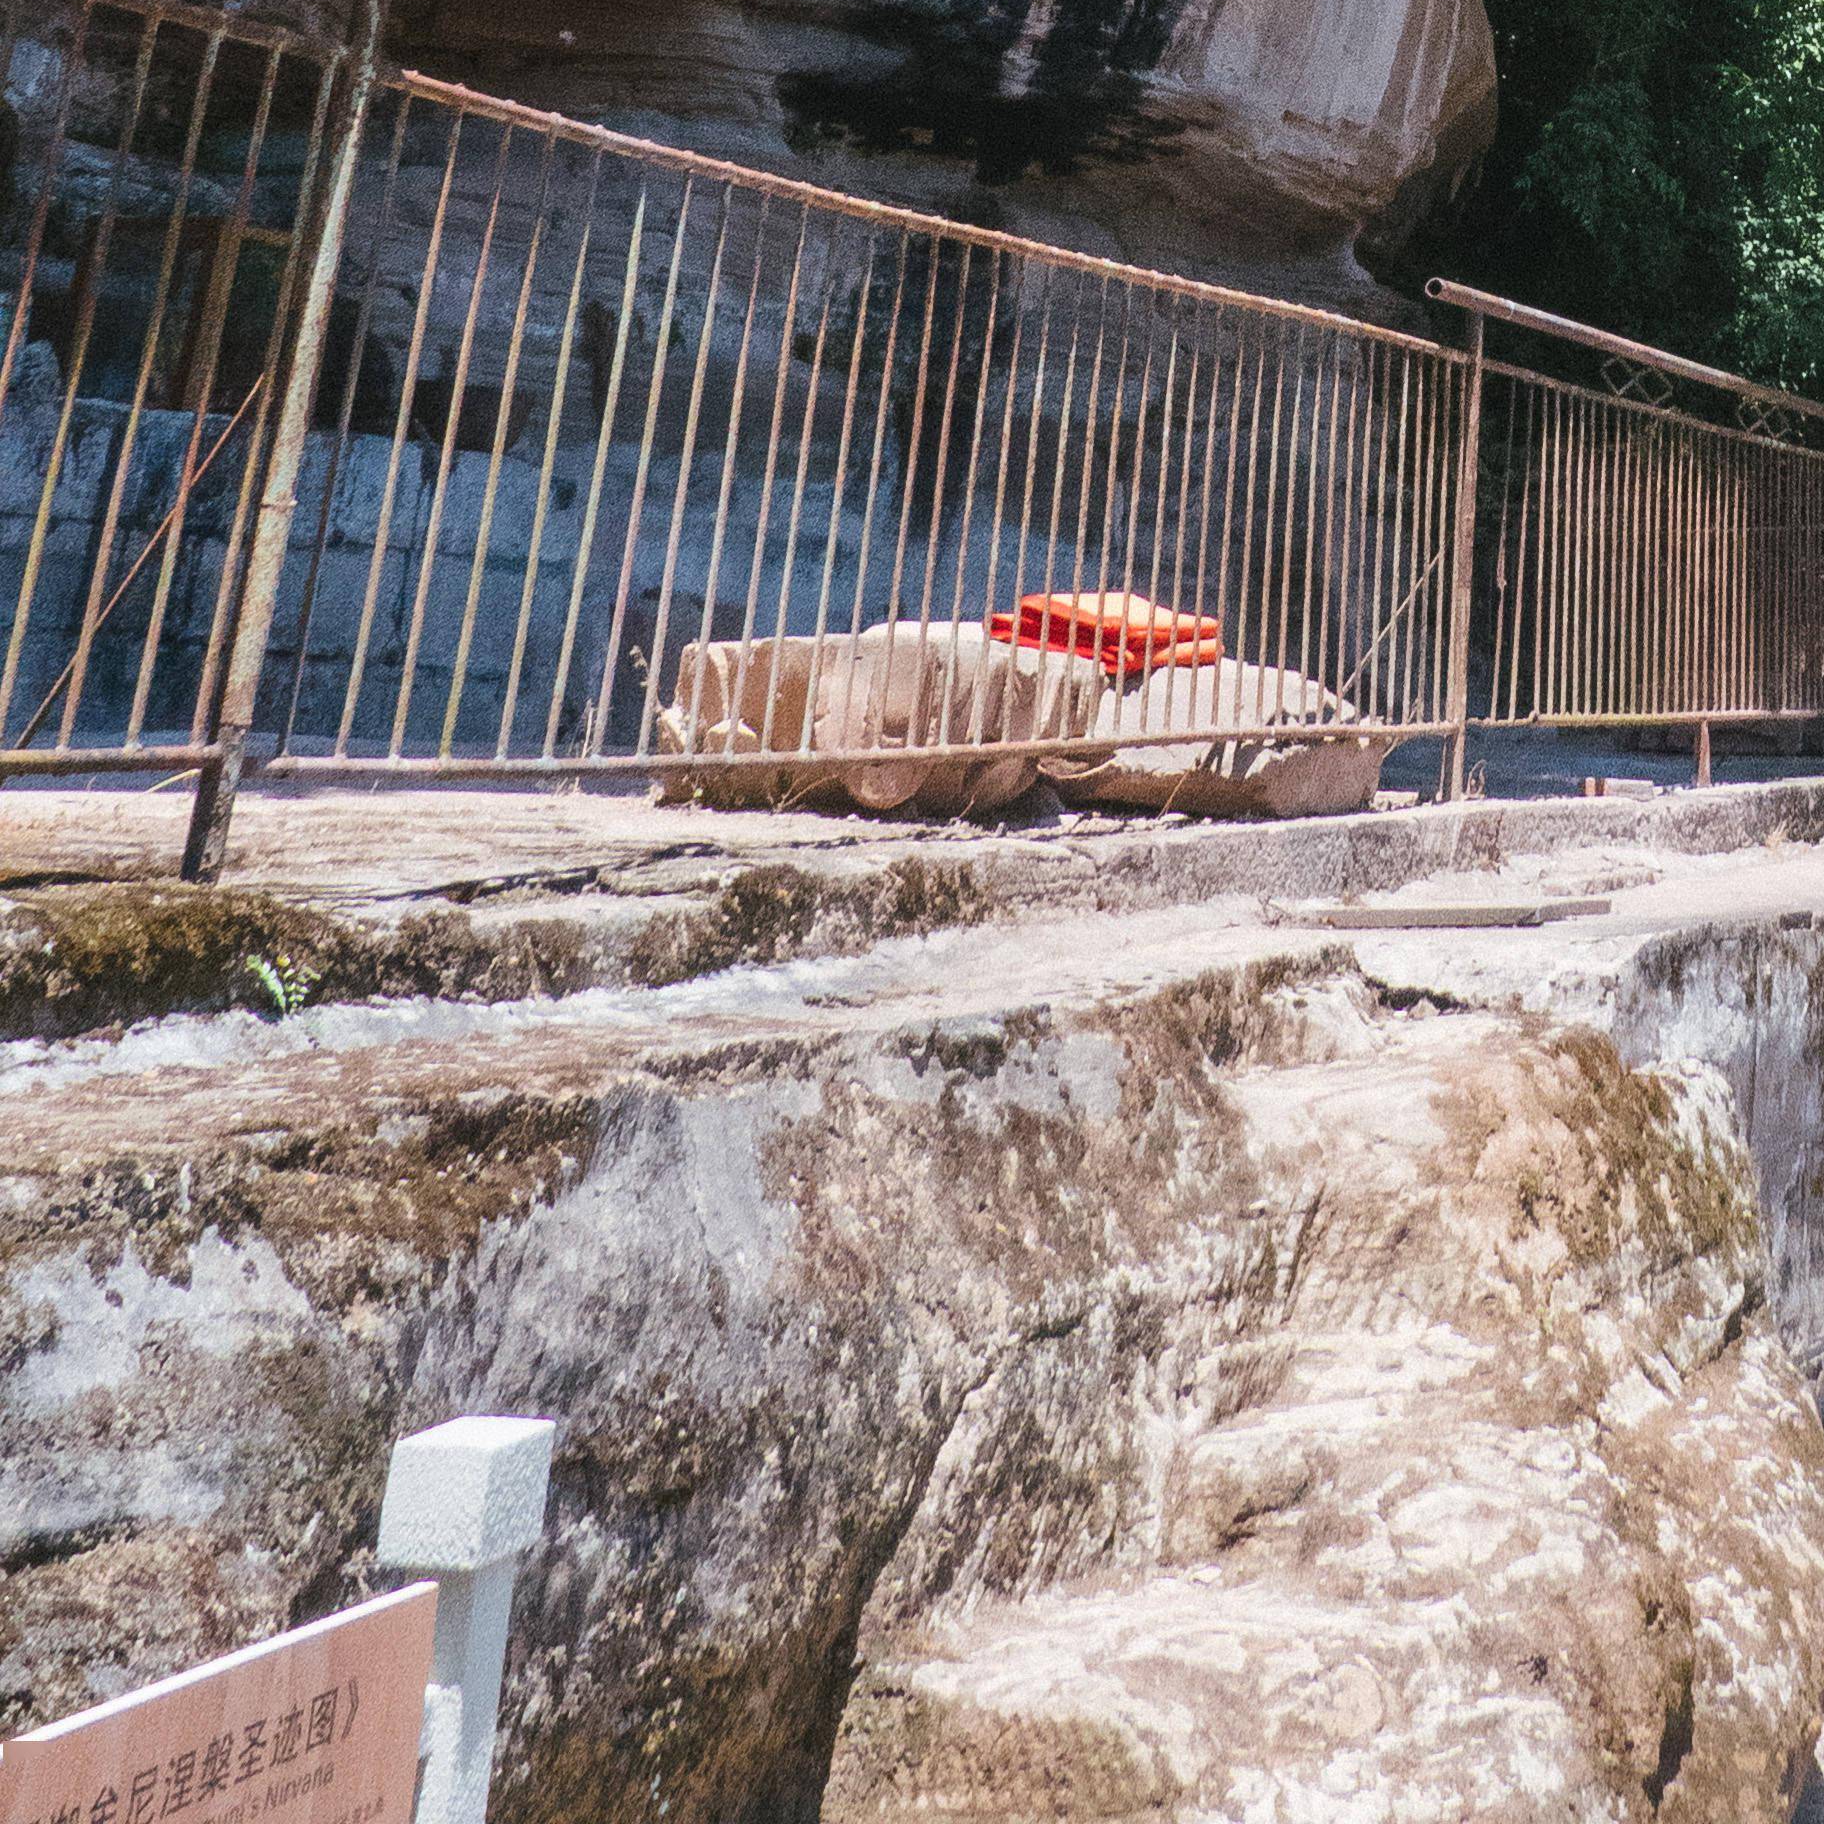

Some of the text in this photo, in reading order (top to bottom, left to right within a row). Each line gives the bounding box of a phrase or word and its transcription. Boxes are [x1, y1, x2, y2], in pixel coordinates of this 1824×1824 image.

[31, 1678, 358, 1824] 牟尼涅槃圣迹图》
[264, 1761, 334, 1810] Nirvana
